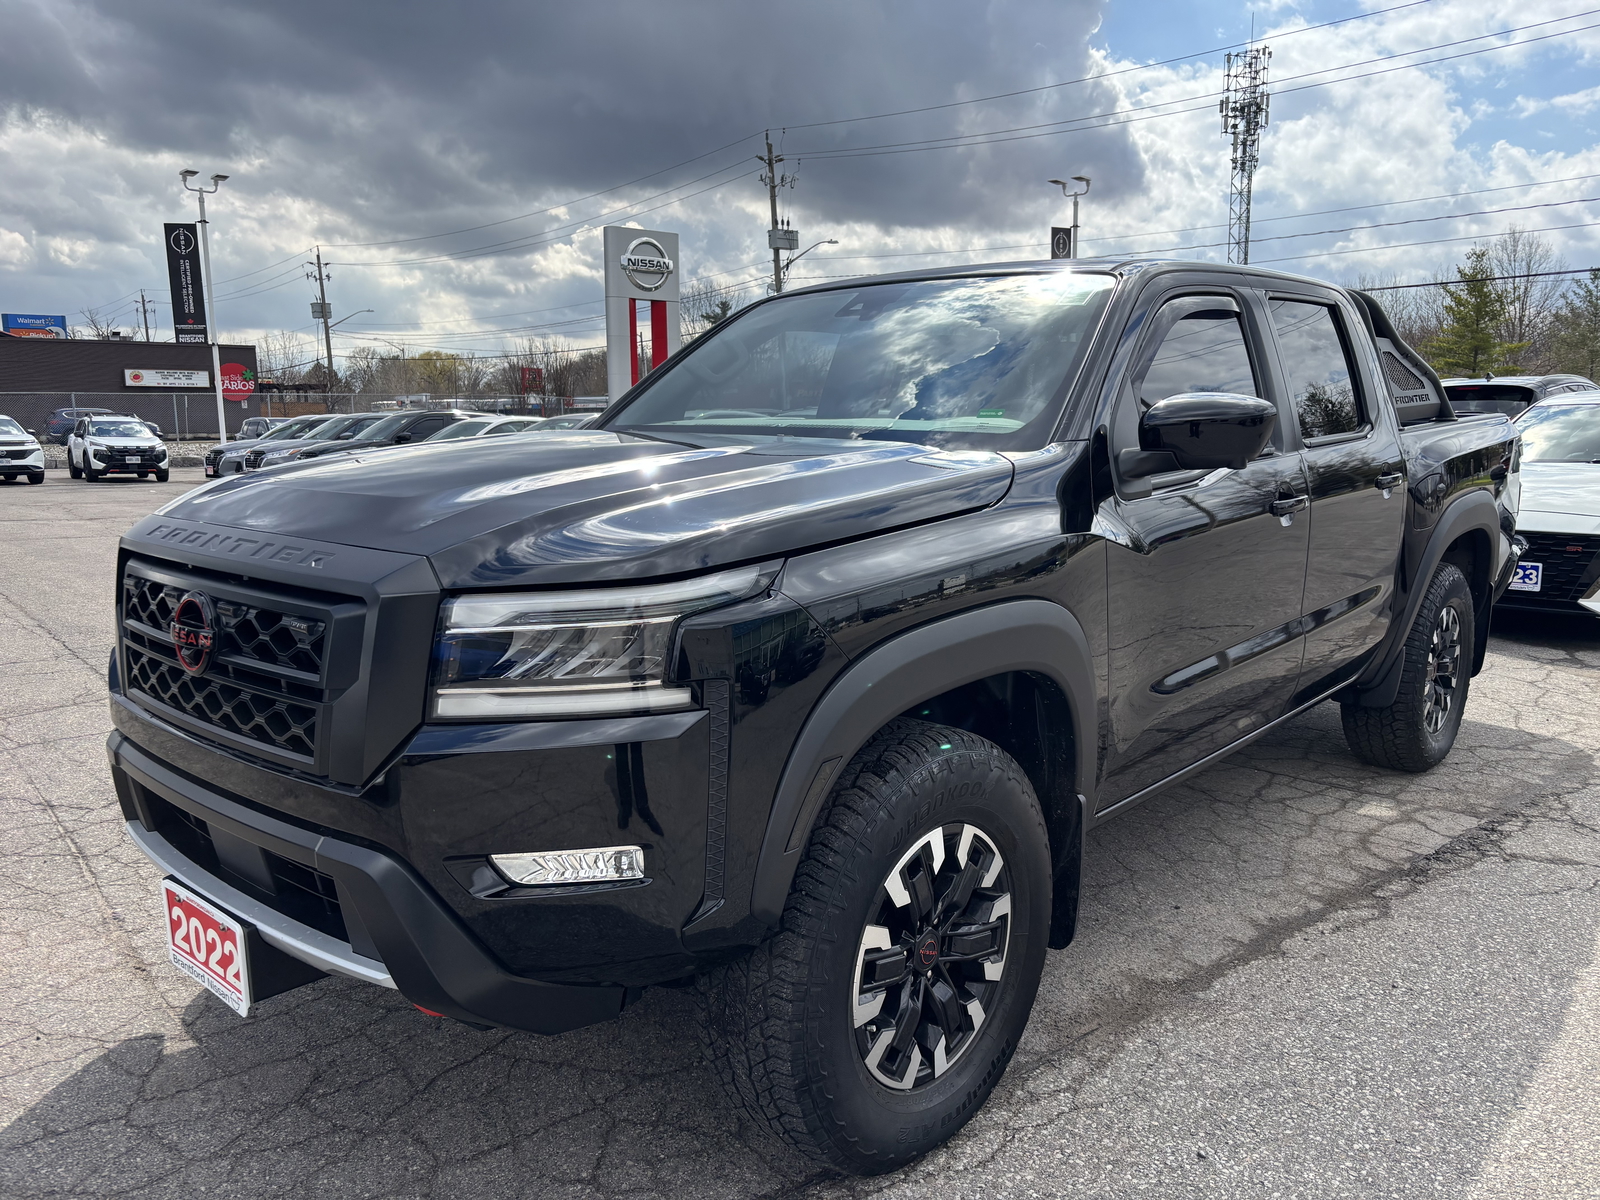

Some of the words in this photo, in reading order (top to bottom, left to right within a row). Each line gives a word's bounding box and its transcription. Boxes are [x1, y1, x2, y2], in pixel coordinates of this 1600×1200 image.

[179, 259, 187, 288] INTELLIGENT
[184, 259, 192, 284] CERTIFIED
[627, 257, 670, 270] NISSAN
[187, 284, 195, 314] PRE-OWNED
[17, 317, 45, 325] Walmart
[230, 373, 243, 381] Side
[1394, 393, 1431, 405] FRONTIER
[146, 524, 336, 569] FRONTIER
[171, 906, 241, 989] 2022
[172, 953, 206, 983] Brantford
[207, 977, 231, 1004] Nissan
